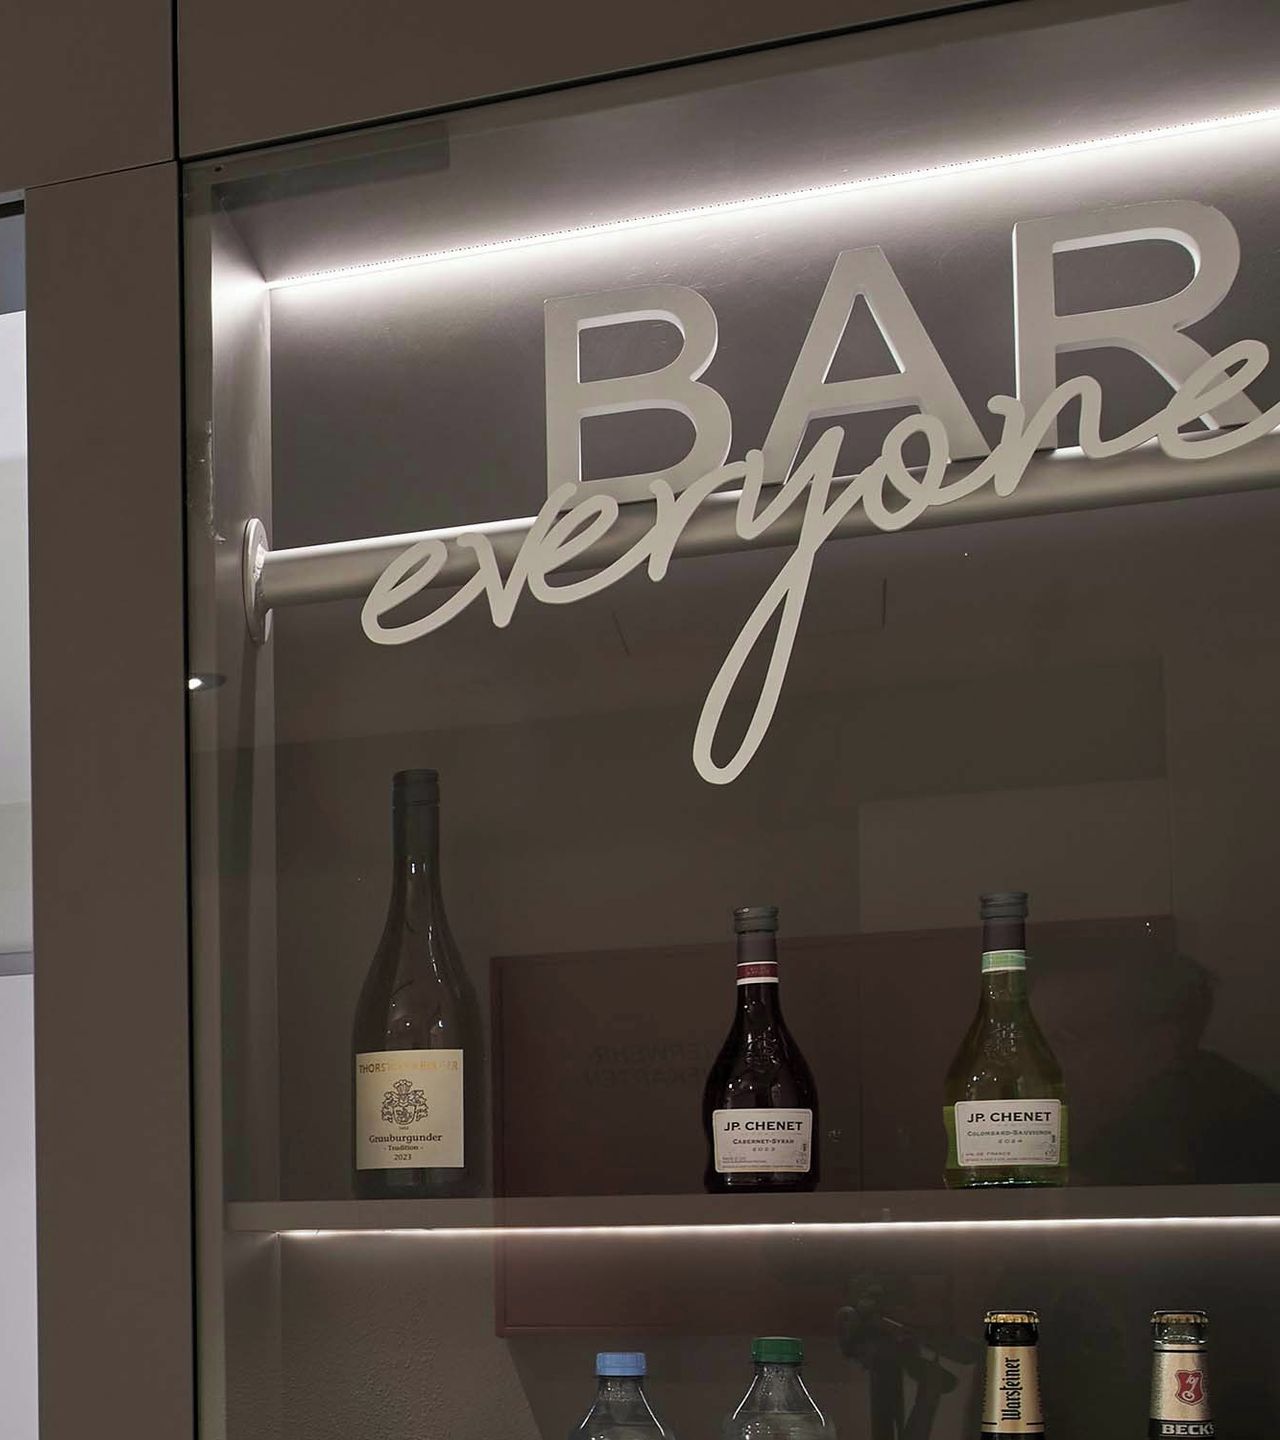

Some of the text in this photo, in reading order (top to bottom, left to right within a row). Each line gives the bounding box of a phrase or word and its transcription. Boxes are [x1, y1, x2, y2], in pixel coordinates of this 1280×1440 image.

[544, 201, 1263, 505] BAR
[360, 338, 1280, 784] everyone
[967, 1112, 1052, 1123] JP. CHENET
[724, 1121, 804, 1131] JP. CHENET
[369, 1133, 443, 1144] Grauburgunder
[394, 1153, 412, 1161] 2023
[999, 1357, 1023, 1421] Warsteiner
